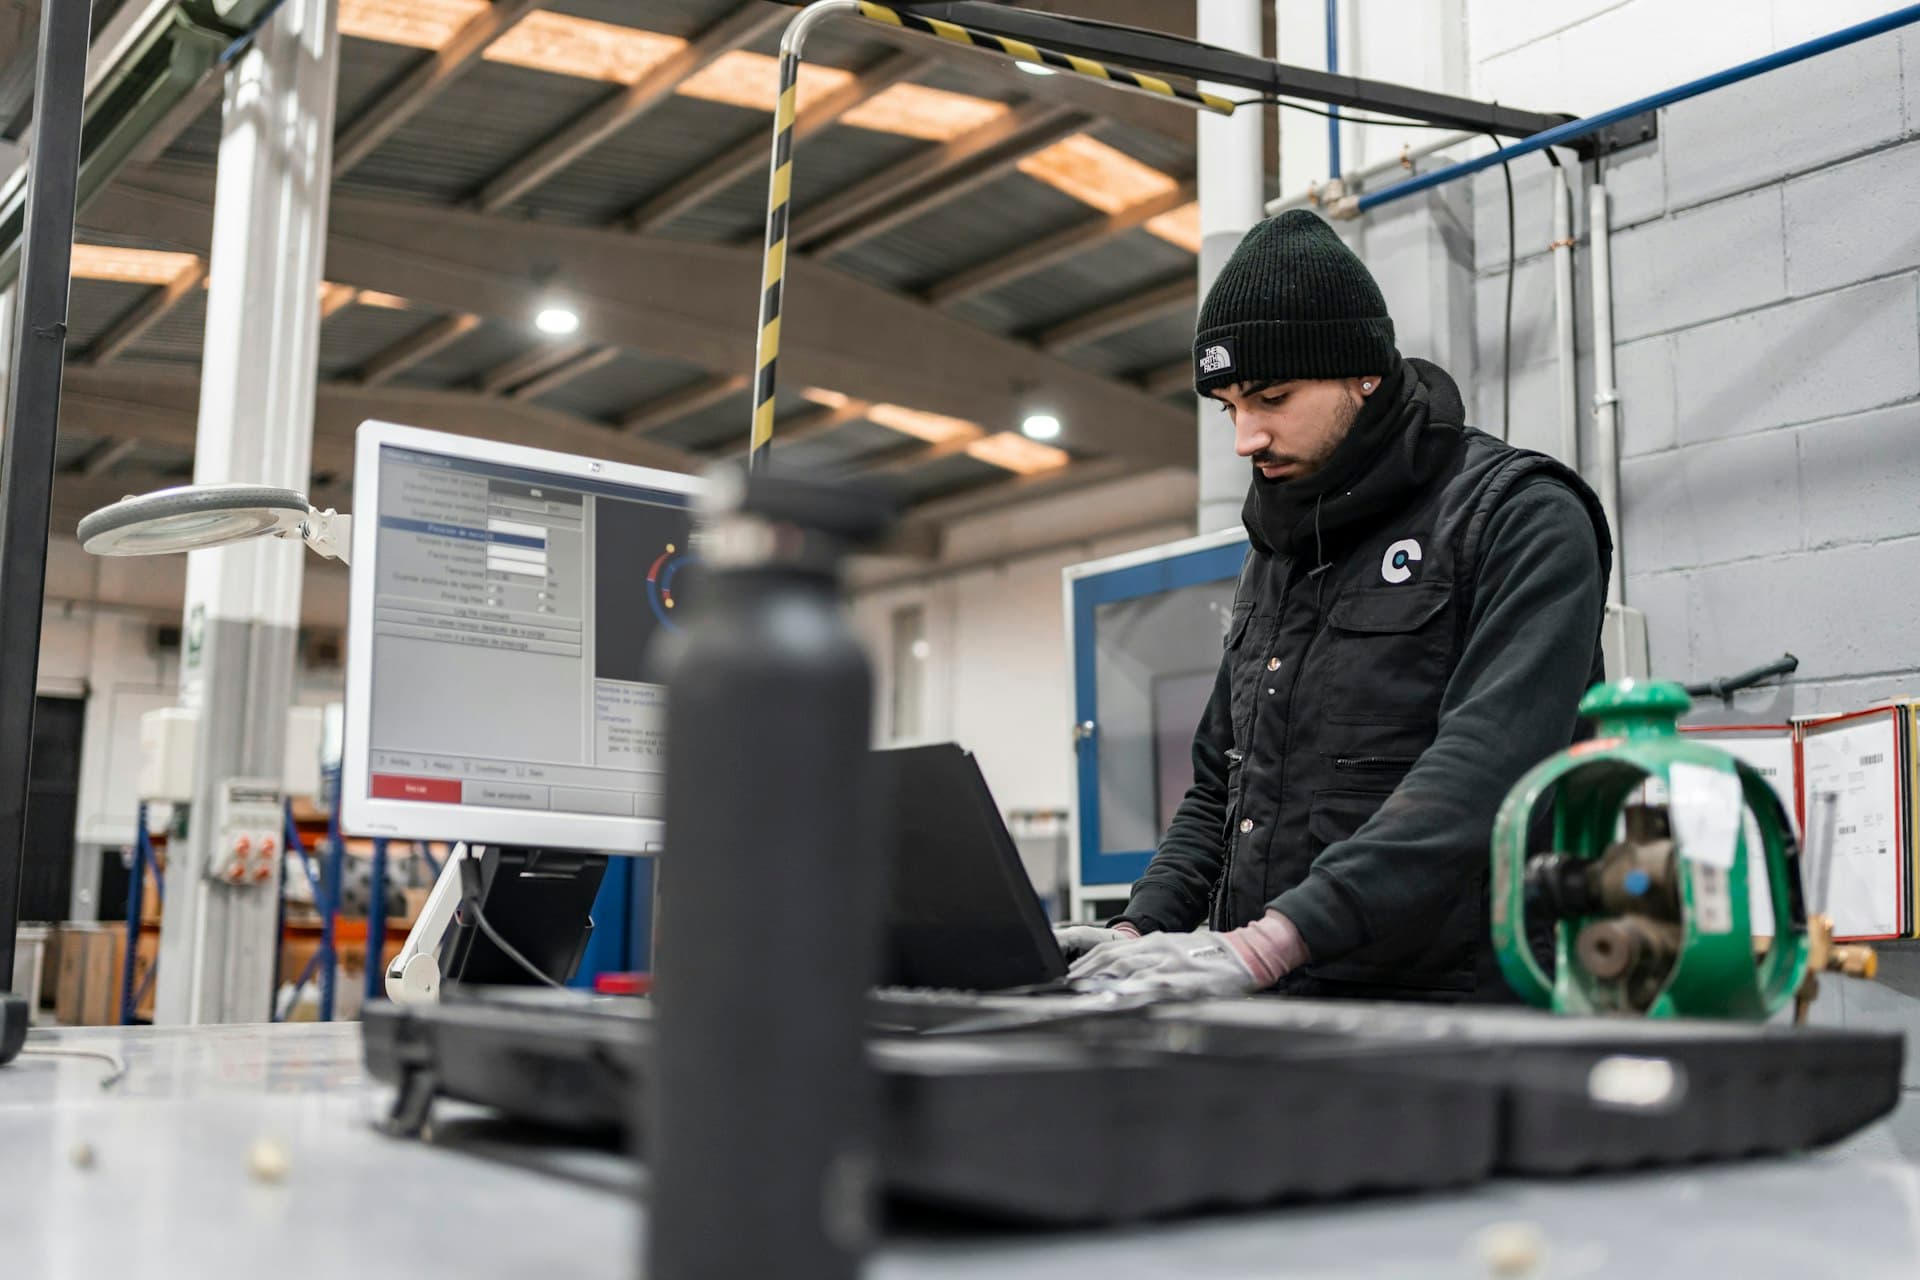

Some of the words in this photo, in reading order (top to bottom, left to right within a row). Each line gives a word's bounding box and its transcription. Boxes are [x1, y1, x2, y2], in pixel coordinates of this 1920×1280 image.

[1205, 347, 1217, 357] THE
[1200, 354, 1217, 368] NORTH
[1204, 363, 1219, 374] FACE
